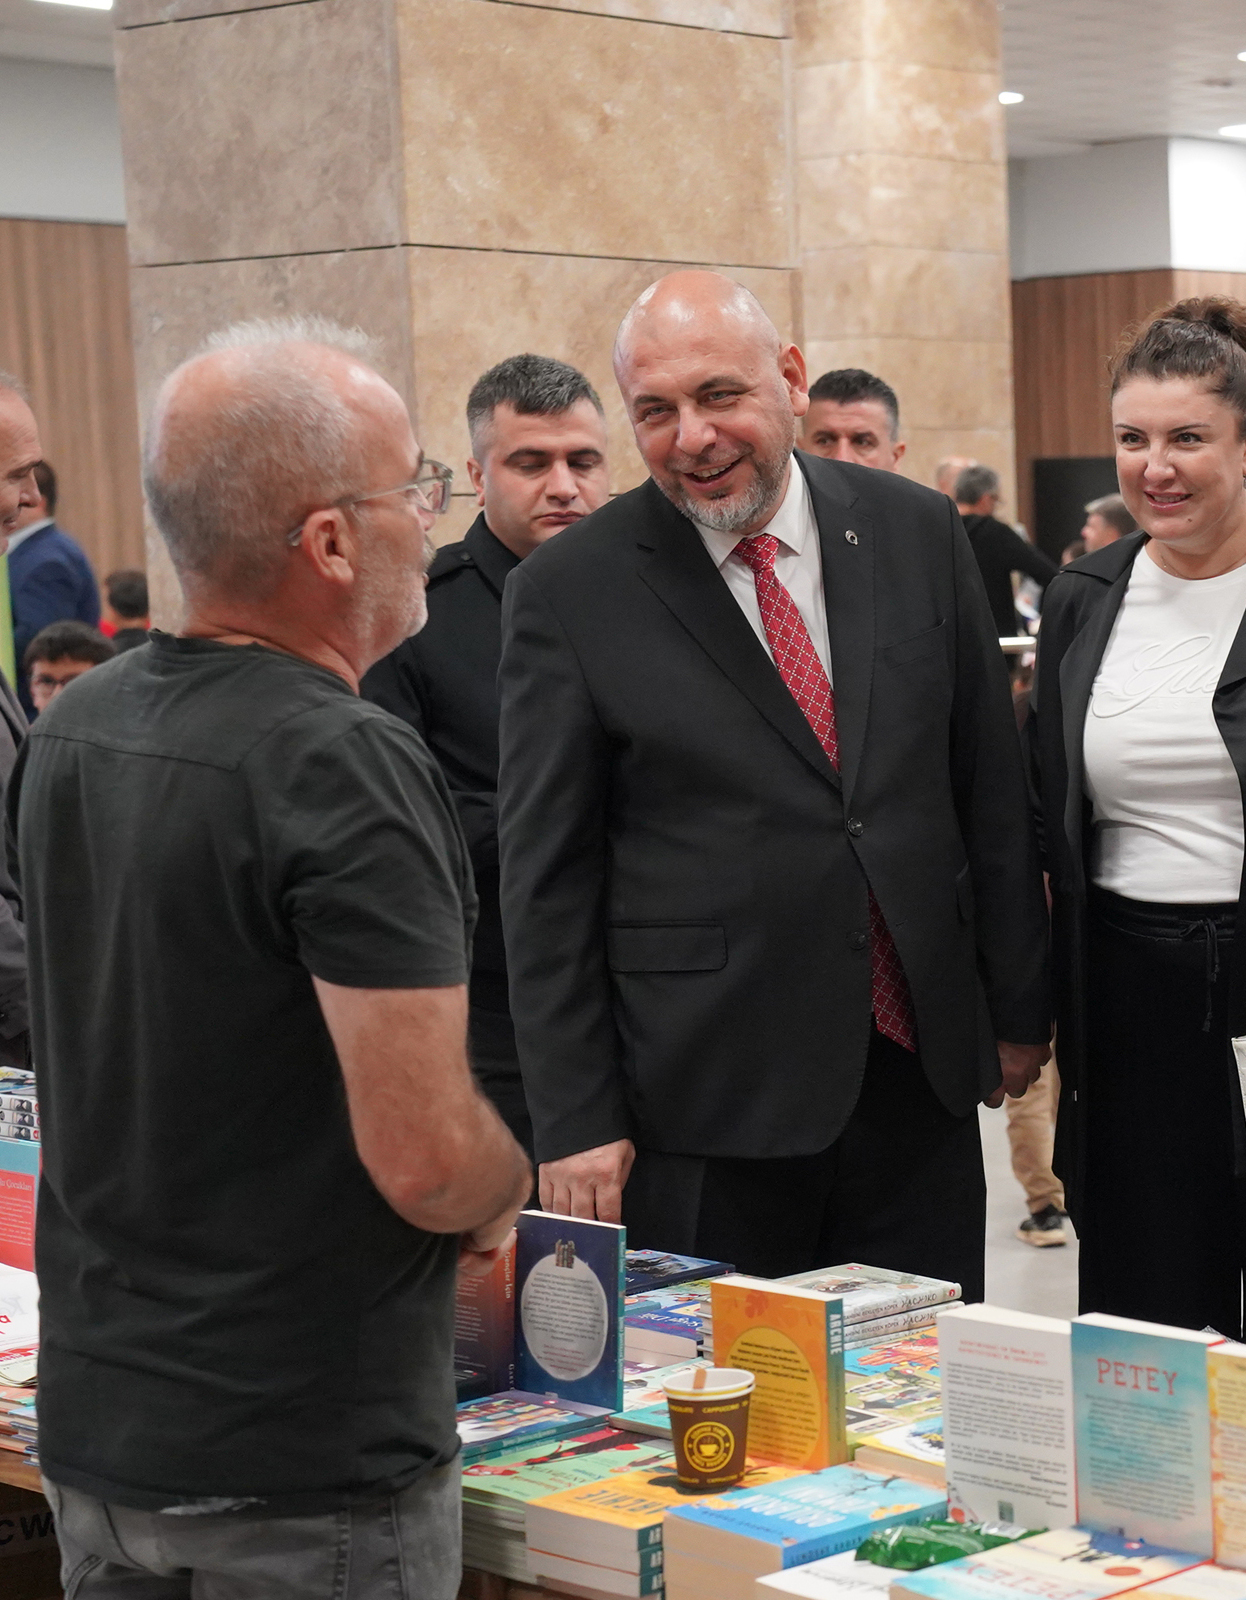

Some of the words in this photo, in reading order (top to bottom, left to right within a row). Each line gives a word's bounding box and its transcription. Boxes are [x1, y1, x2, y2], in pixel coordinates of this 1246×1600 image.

[830, 1313, 843, 1355] ARCHIE
[1097, 1358, 1178, 1396] PETEY
[20, 1511, 57, 1541] W
